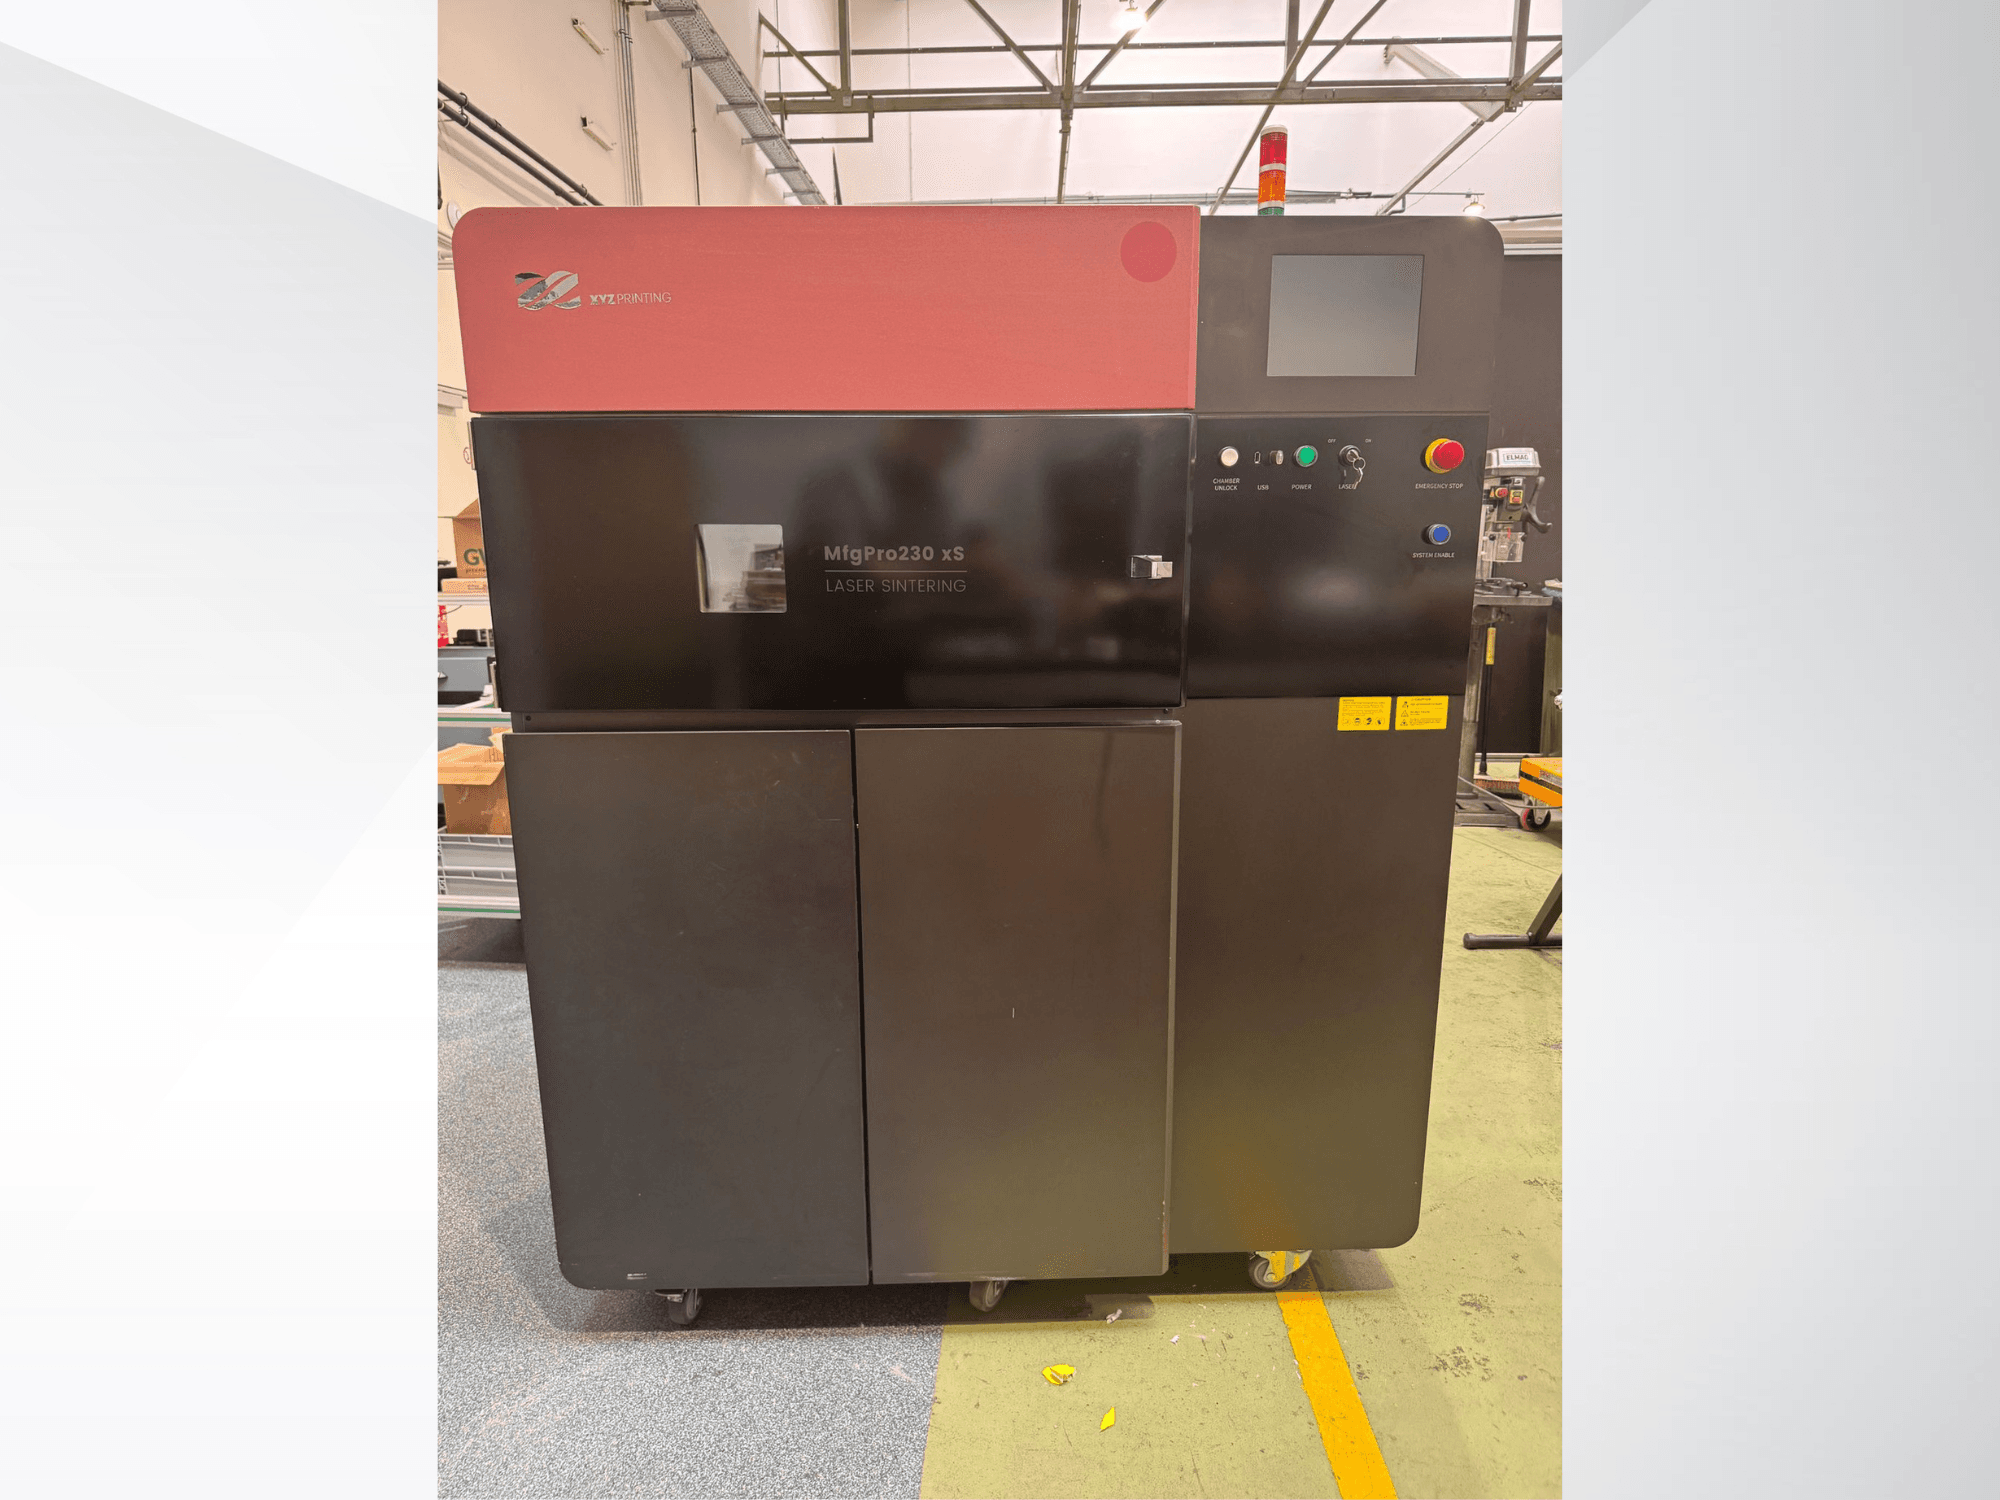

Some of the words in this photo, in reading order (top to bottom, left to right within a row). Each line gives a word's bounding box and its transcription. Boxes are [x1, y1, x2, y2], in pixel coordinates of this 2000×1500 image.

[590, 292, 672, 305] XYZPRINTING
[824, 545, 934, 566] MfgPro230
[941, 546, 965, 561] xS
[826, 579, 875, 592] LASER
[881, 579, 967, 592] SINTERING
